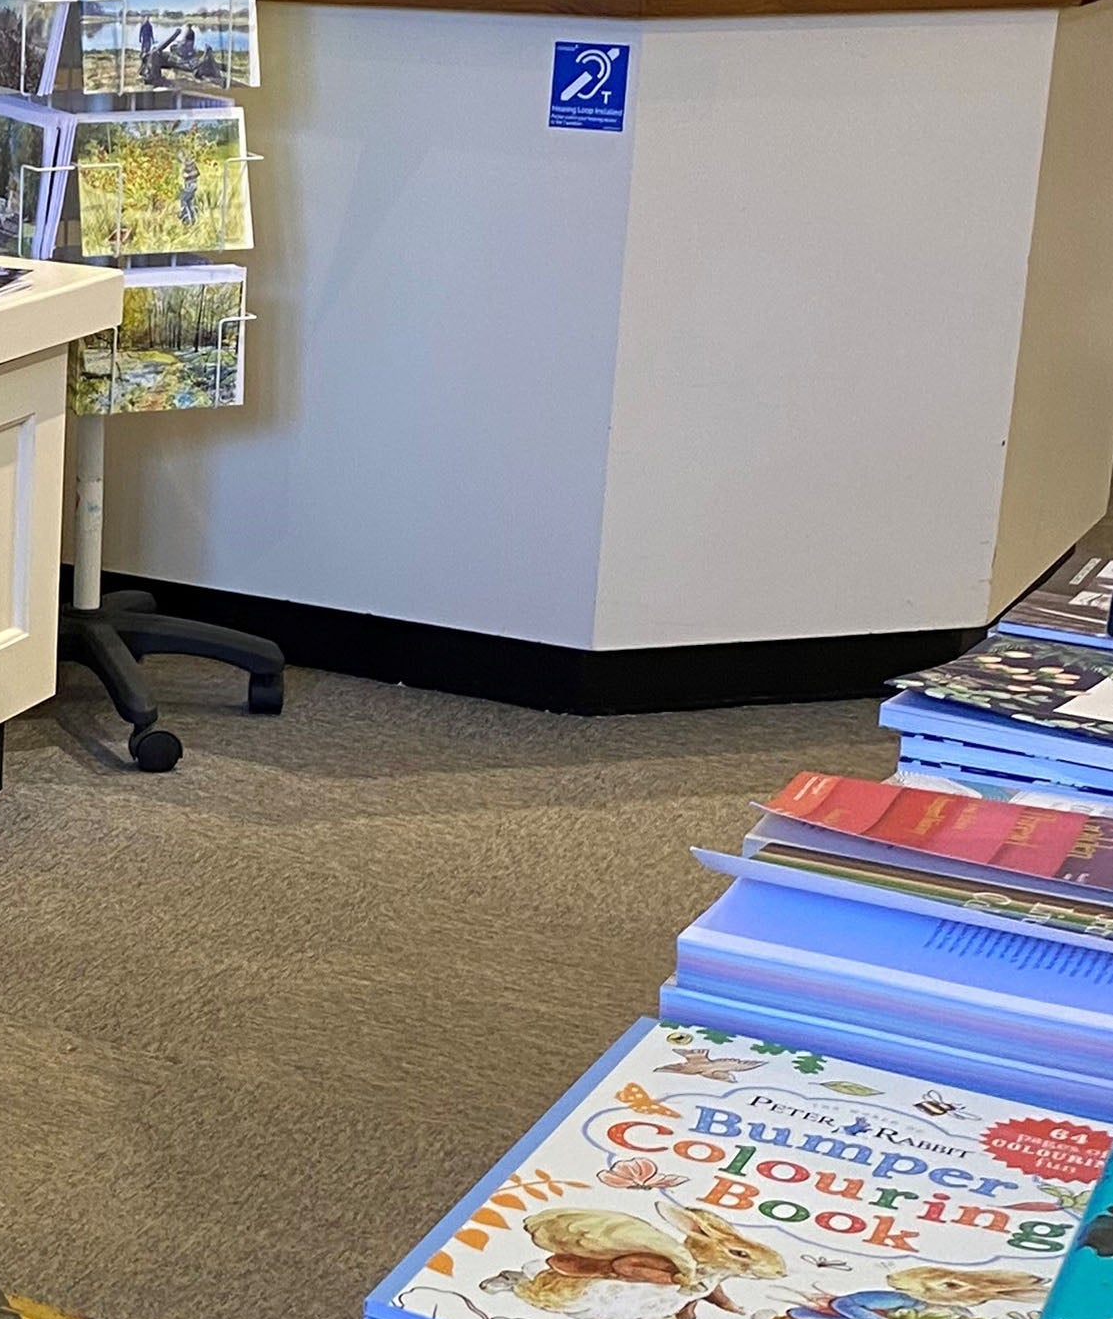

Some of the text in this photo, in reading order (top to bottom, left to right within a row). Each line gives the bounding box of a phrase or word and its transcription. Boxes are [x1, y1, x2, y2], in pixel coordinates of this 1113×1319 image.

[601, 91, 612, 105] T
[577, 106, 594, 114] Loop
[747, 1093, 975, 1162] PETER RABBIT
[1049, 1128, 1089, 1145] 64
[687, 1106, 1021, 1198] Bumper
[1016, 1133, 1080, 1153] pages
[1035, 1157, 1077, 1173] fun
[607, 1121, 1076, 1253] Colouring
[695, 1175, 921, 1254] Book
